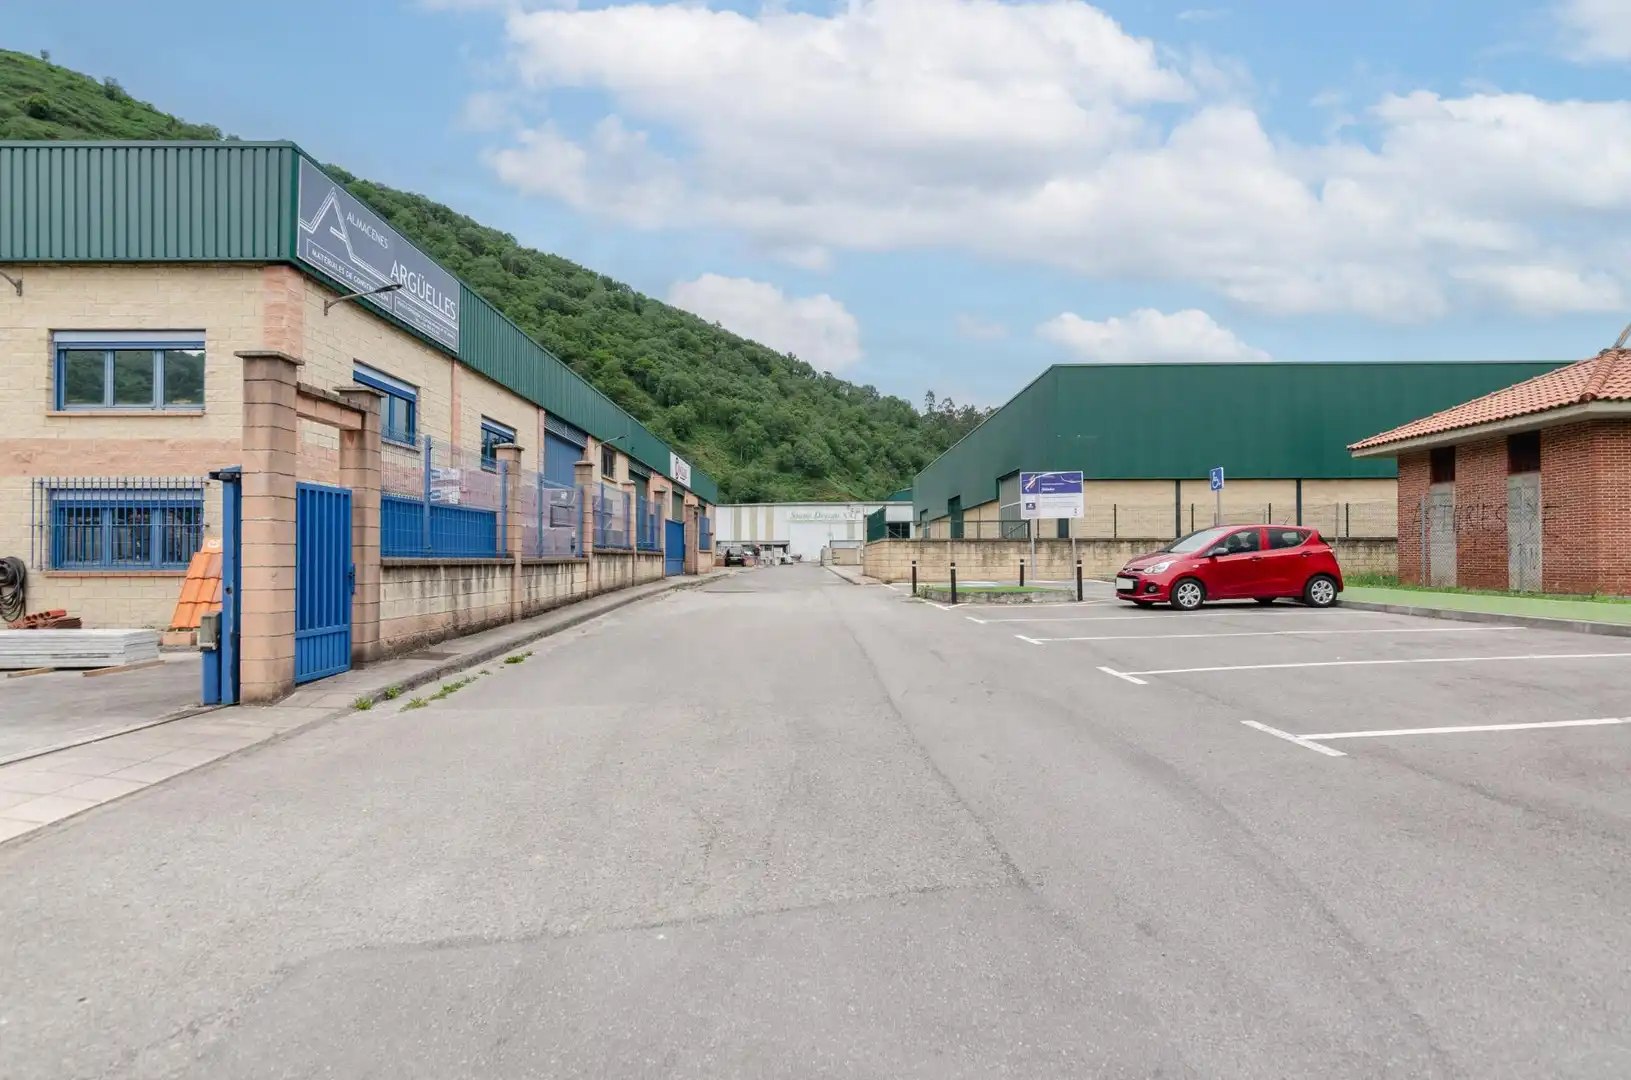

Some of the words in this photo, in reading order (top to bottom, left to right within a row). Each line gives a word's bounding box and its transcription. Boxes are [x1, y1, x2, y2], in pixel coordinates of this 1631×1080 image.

[346, 211, 388, 249] ALMACENES
[311, 247, 345, 275] MATERIALES
[345, 270, 353, 280] DE
[390, 259, 456, 320] ARGÜELLES
